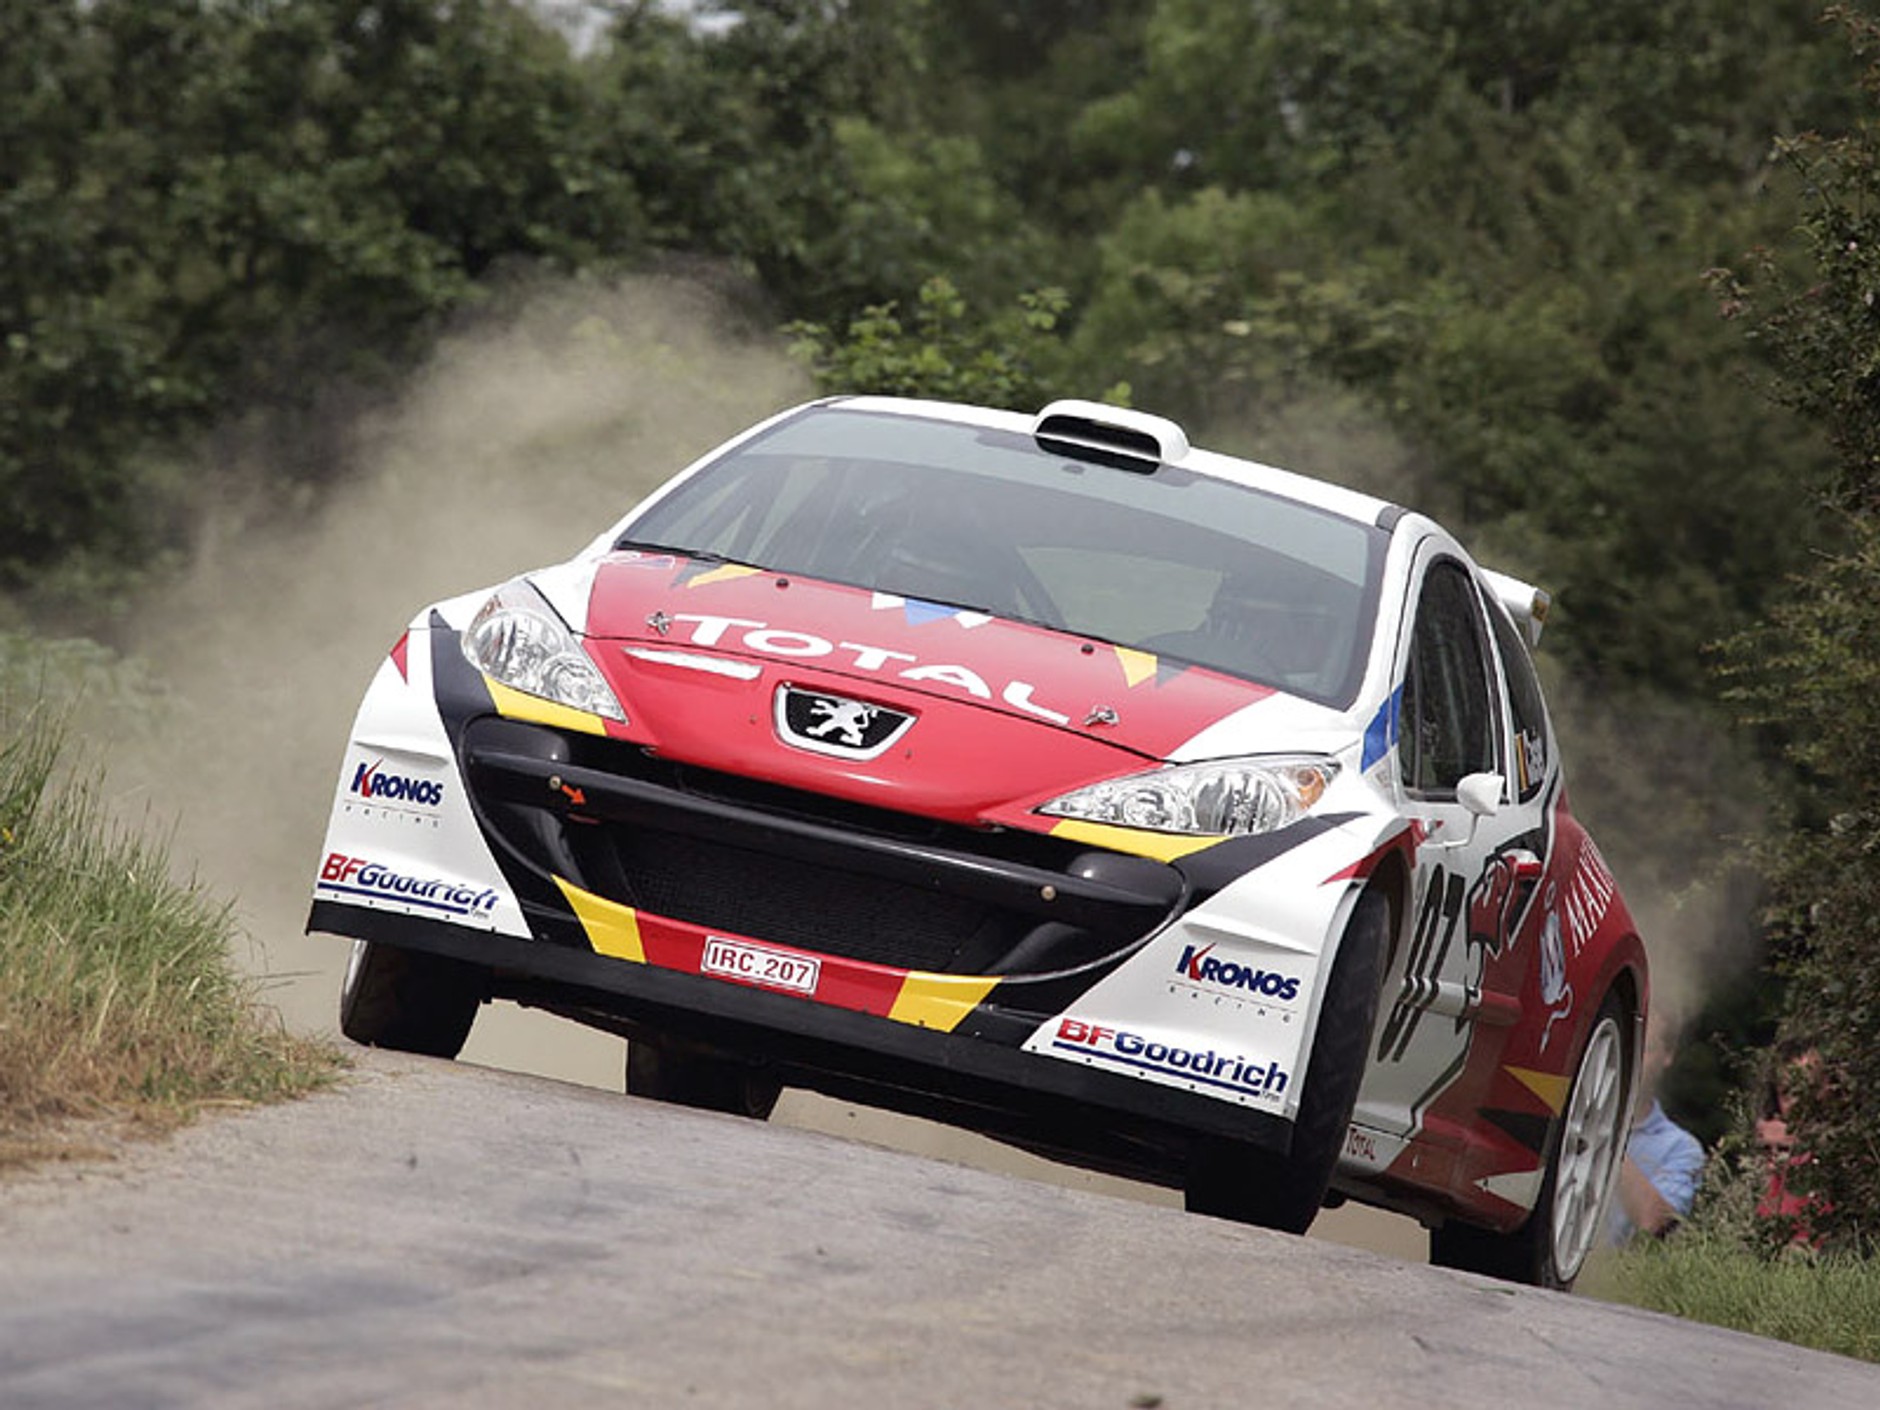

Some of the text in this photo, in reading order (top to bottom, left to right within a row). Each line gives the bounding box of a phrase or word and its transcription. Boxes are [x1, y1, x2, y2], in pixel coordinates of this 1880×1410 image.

[673, 614, 1070, 726] TOTAL
[351, 758, 443, 806] KRONOS
[321, 853, 499, 910] BFGoodrich
[1176, 942, 1300, 1000] KRONOS
[1056, 1018, 1289, 1093] BFGoodrich
